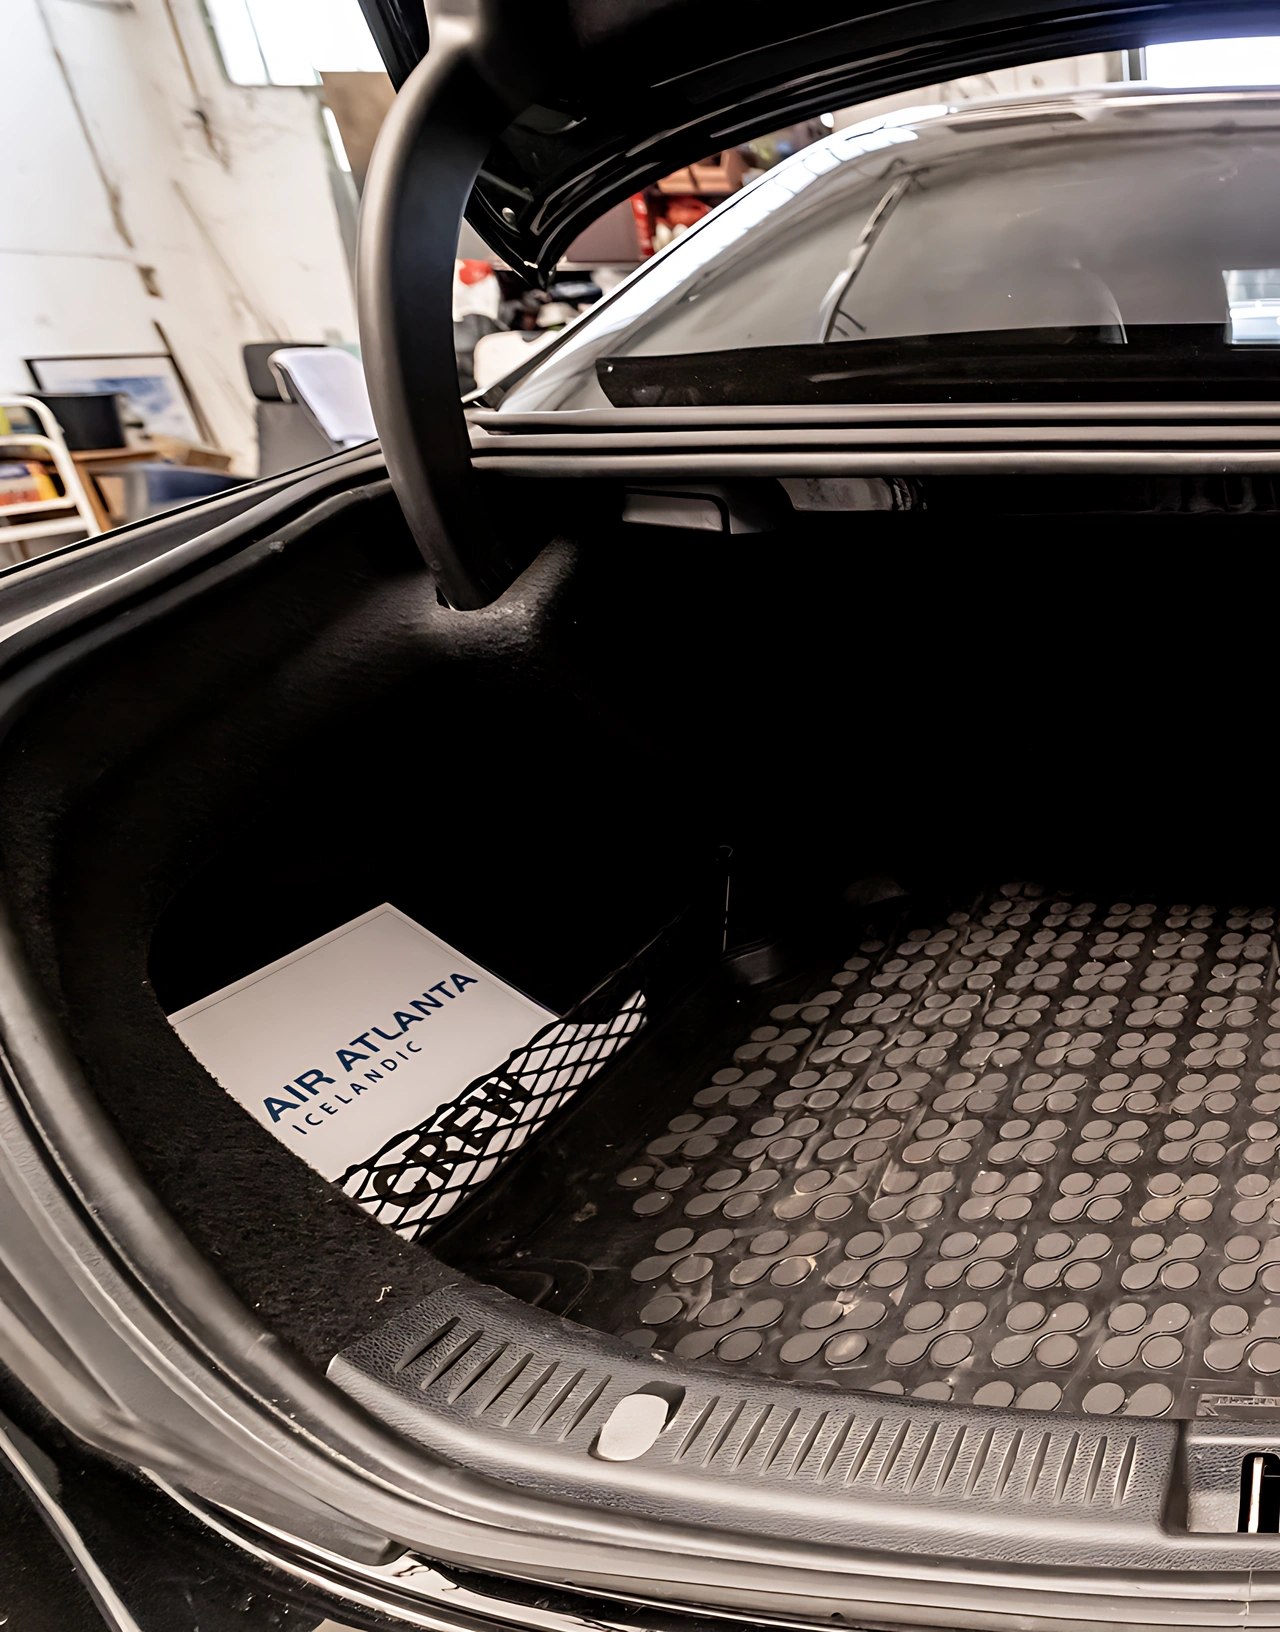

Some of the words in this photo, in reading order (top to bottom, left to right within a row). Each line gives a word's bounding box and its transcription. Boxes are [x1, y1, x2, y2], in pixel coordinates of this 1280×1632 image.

[263, 1068, 336, 1123] AIR
[335, 973, 478, 1072] ATLANTA
[292, 1040, 423, 1135] ICELANDIC
[372, 1074, 532, 1208] CREW
